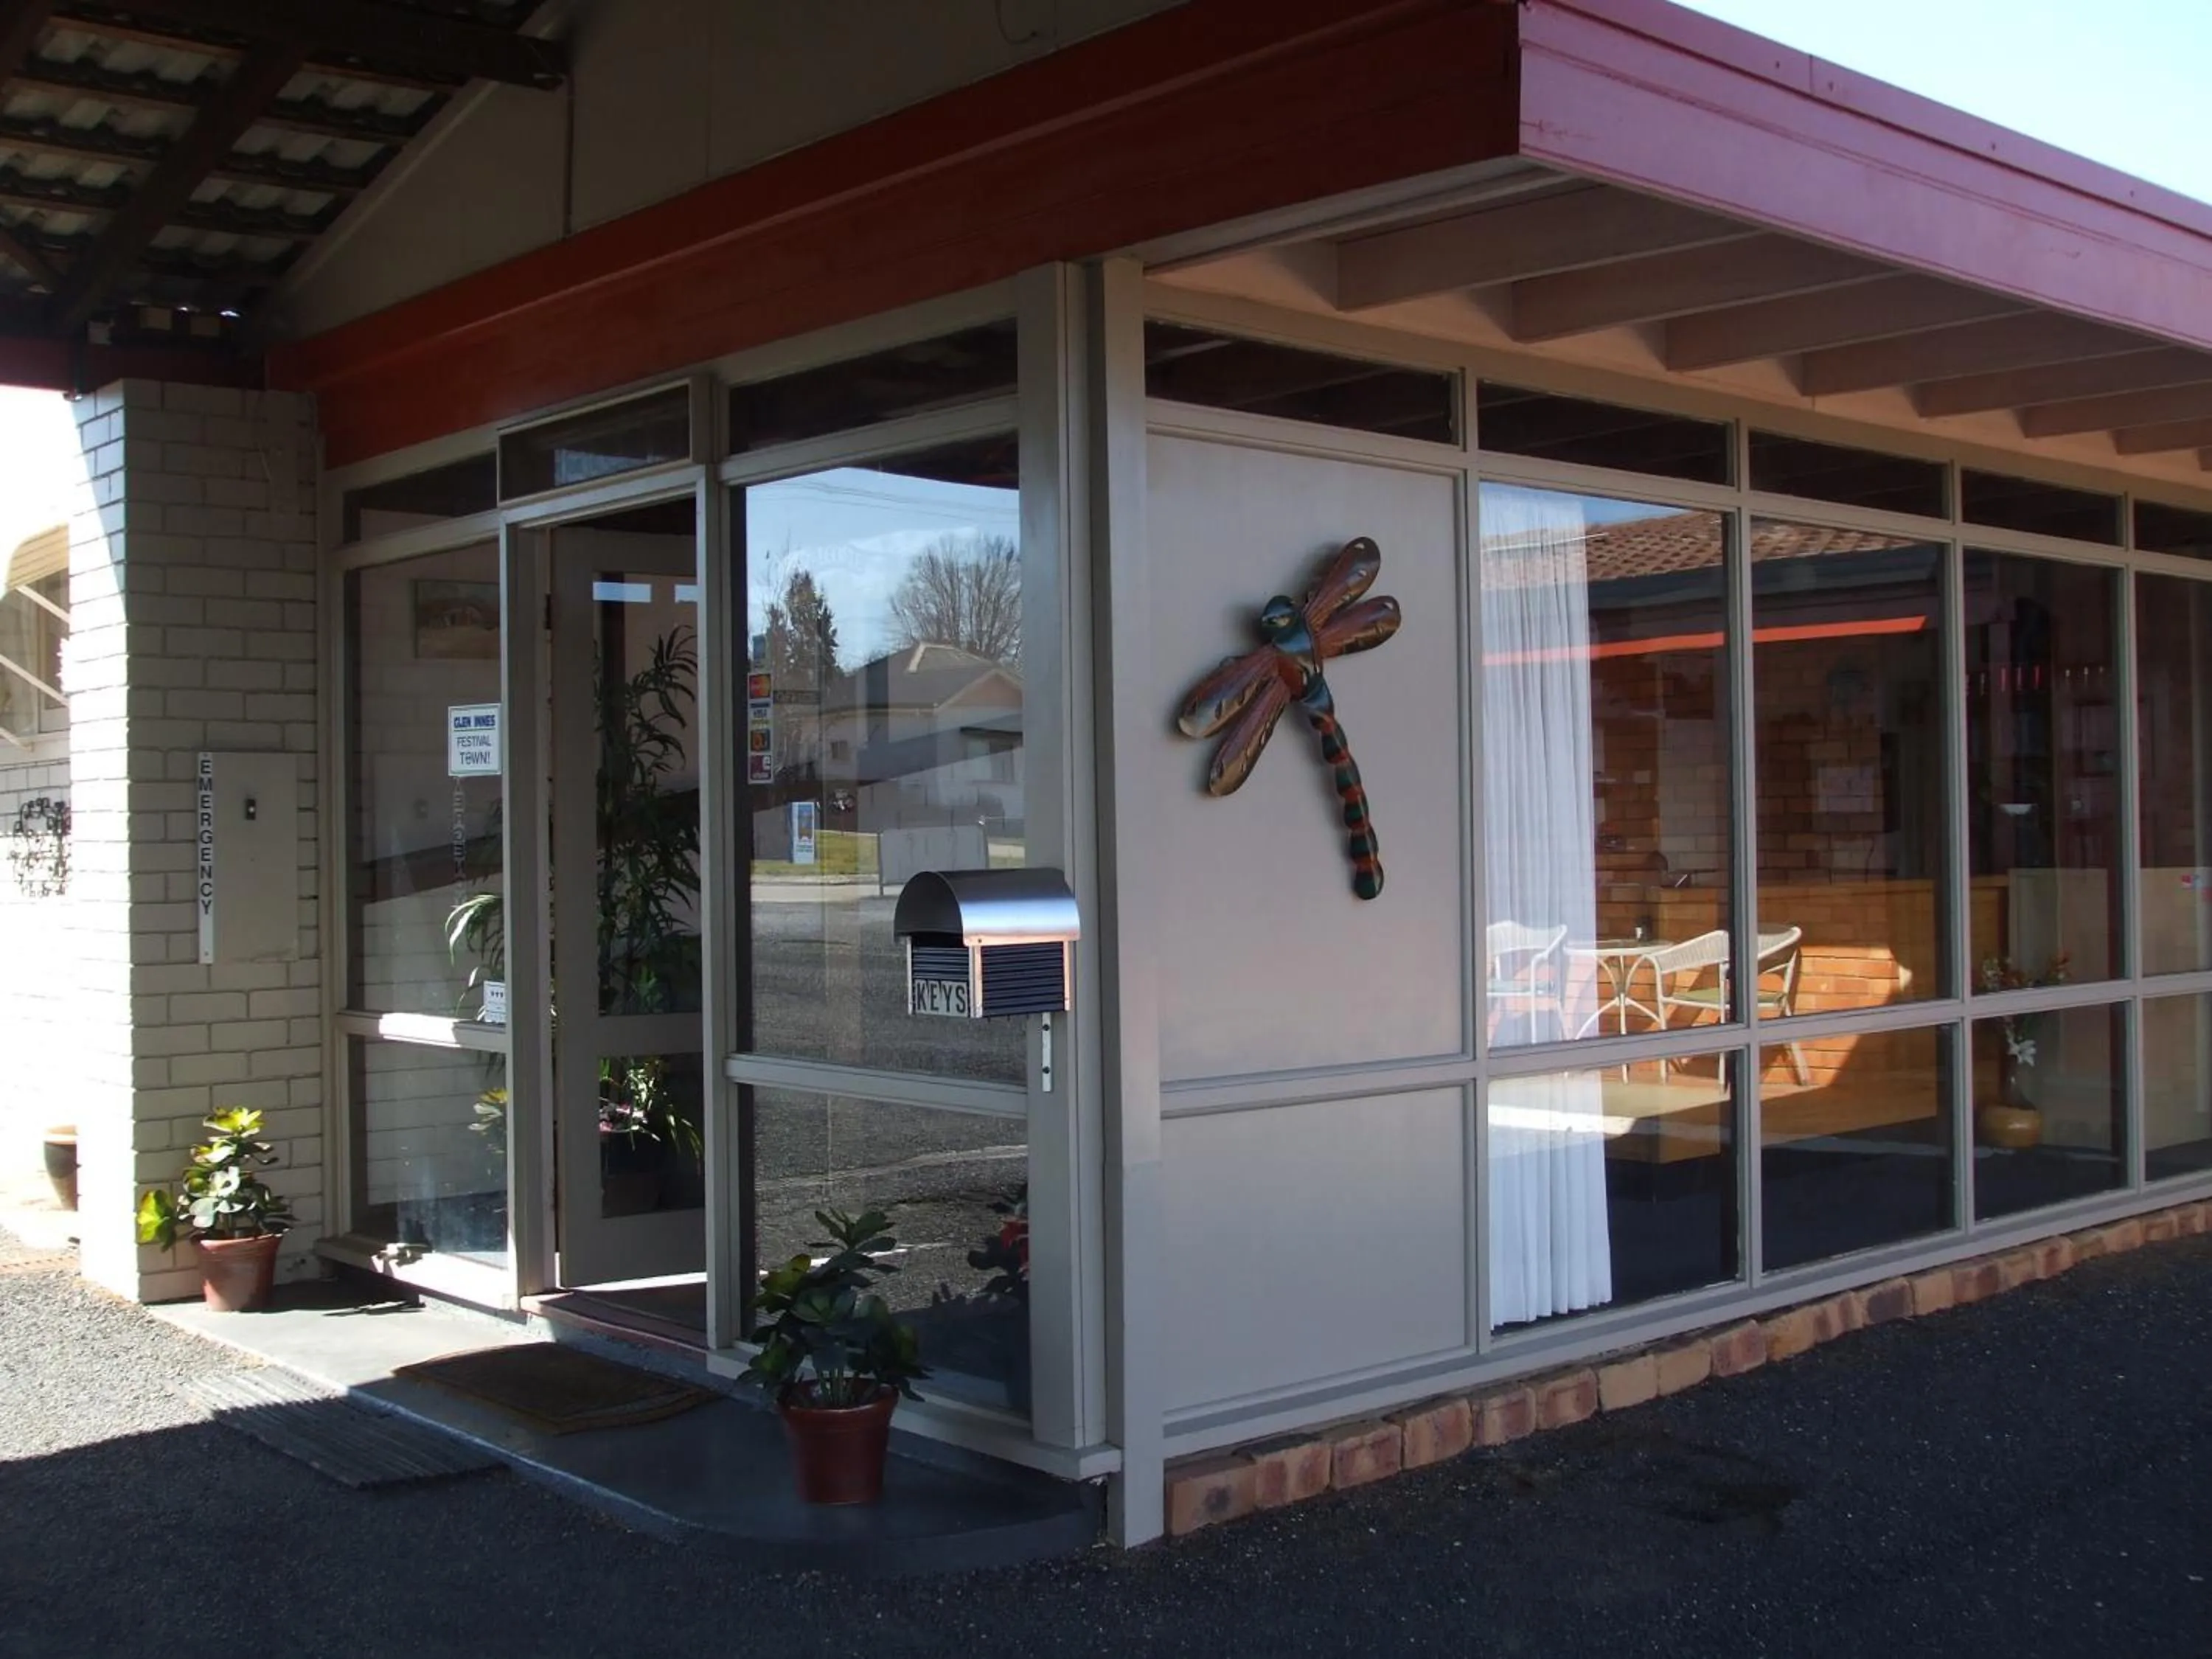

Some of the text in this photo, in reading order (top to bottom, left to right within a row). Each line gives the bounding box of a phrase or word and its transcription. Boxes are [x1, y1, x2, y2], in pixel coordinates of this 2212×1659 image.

[453, 714, 495, 728] GLEN INNES
[456, 735, 492, 748] FESTIVAL
[460, 751, 491, 765] TOWN!
[199, 759, 212, 915] EMERGENCY
[917, 981, 967, 1014] KEYS
